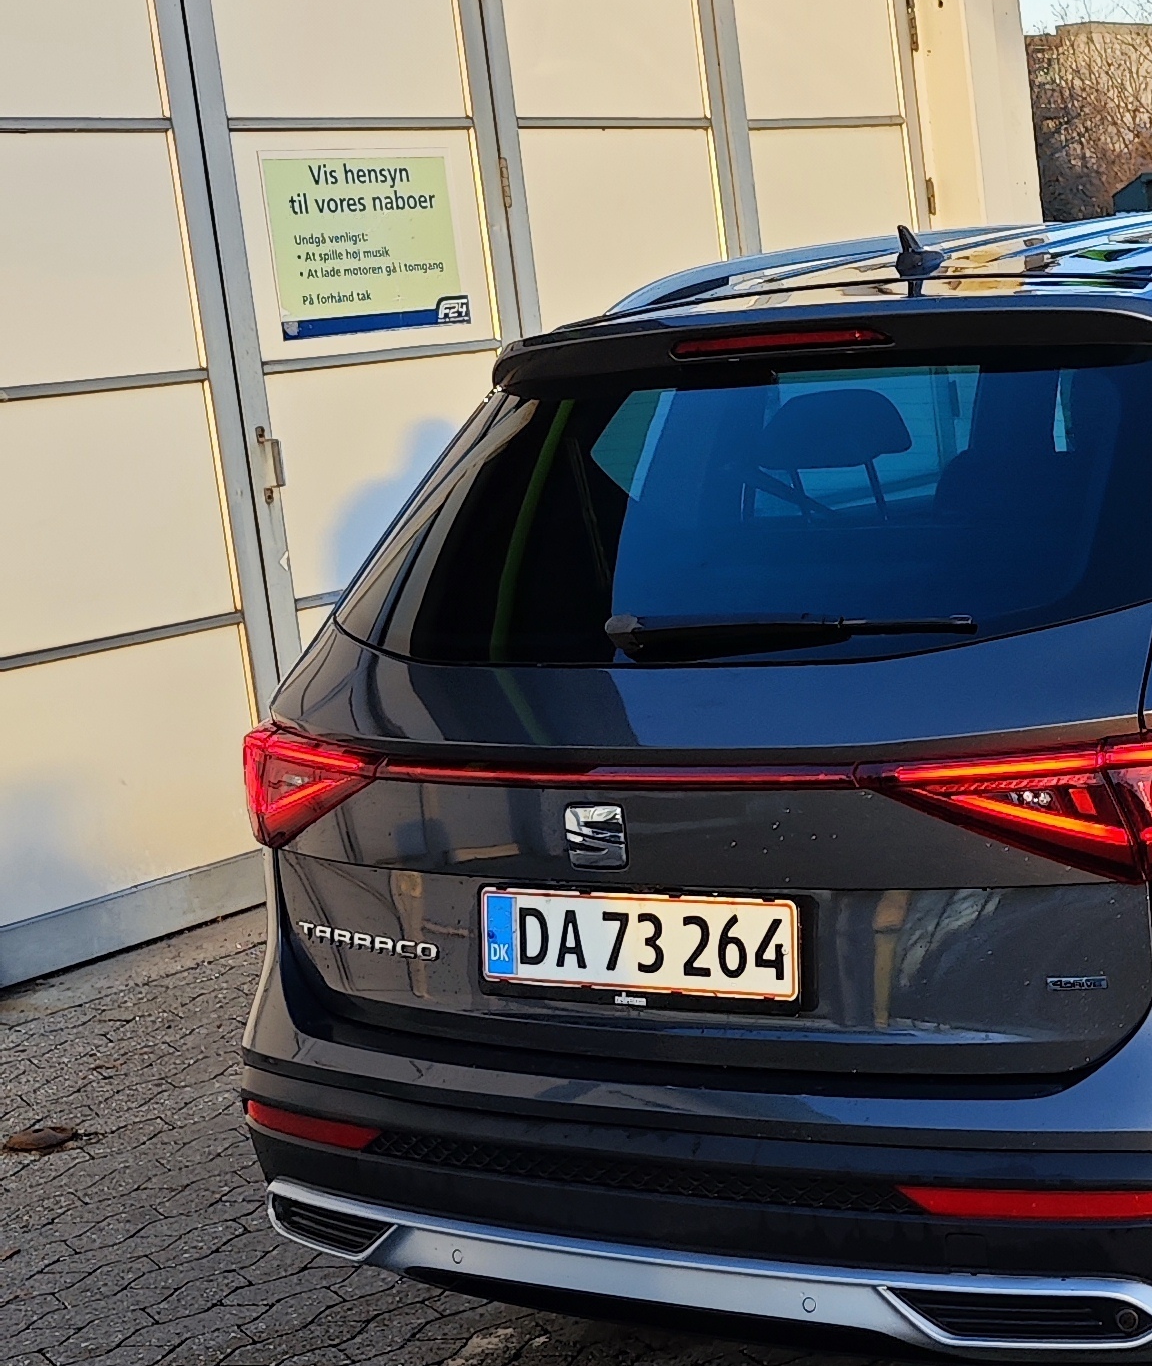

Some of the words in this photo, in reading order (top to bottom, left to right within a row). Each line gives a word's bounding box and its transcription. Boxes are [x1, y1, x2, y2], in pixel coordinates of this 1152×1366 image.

[308, 164, 338, 186] Vis
[343, 163, 410, 188] hensyn
[289, 193, 309, 215] til
[314, 195, 367, 214] vores
[372, 190, 436, 211] naboer
[294, 232, 326, 247] Undgå
[305, 251, 316, 262] At
[319, 249, 343, 263] spille
[363, 246, 390, 258] musik
[307, 268, 319, 279] At
[320, 266, 341, 278] lade
[343, 265, 383, 277] motoren
[385, 262, 397, 276] gå
[404, 261, 444, 274] tomgang
[302, 293, 314, 306] På
[317, 291, 354, 304] forhånd
[357, 290, 372, 302] tak
[437, 298, 468, 318] F24
[298, 920, 440, 961] TARRACO
[518, 907, 587, 969] DA
[602, 911, 665, 974] 73
[682, 914, 785, 981] 264
[490, 943, 510, 962] DK
